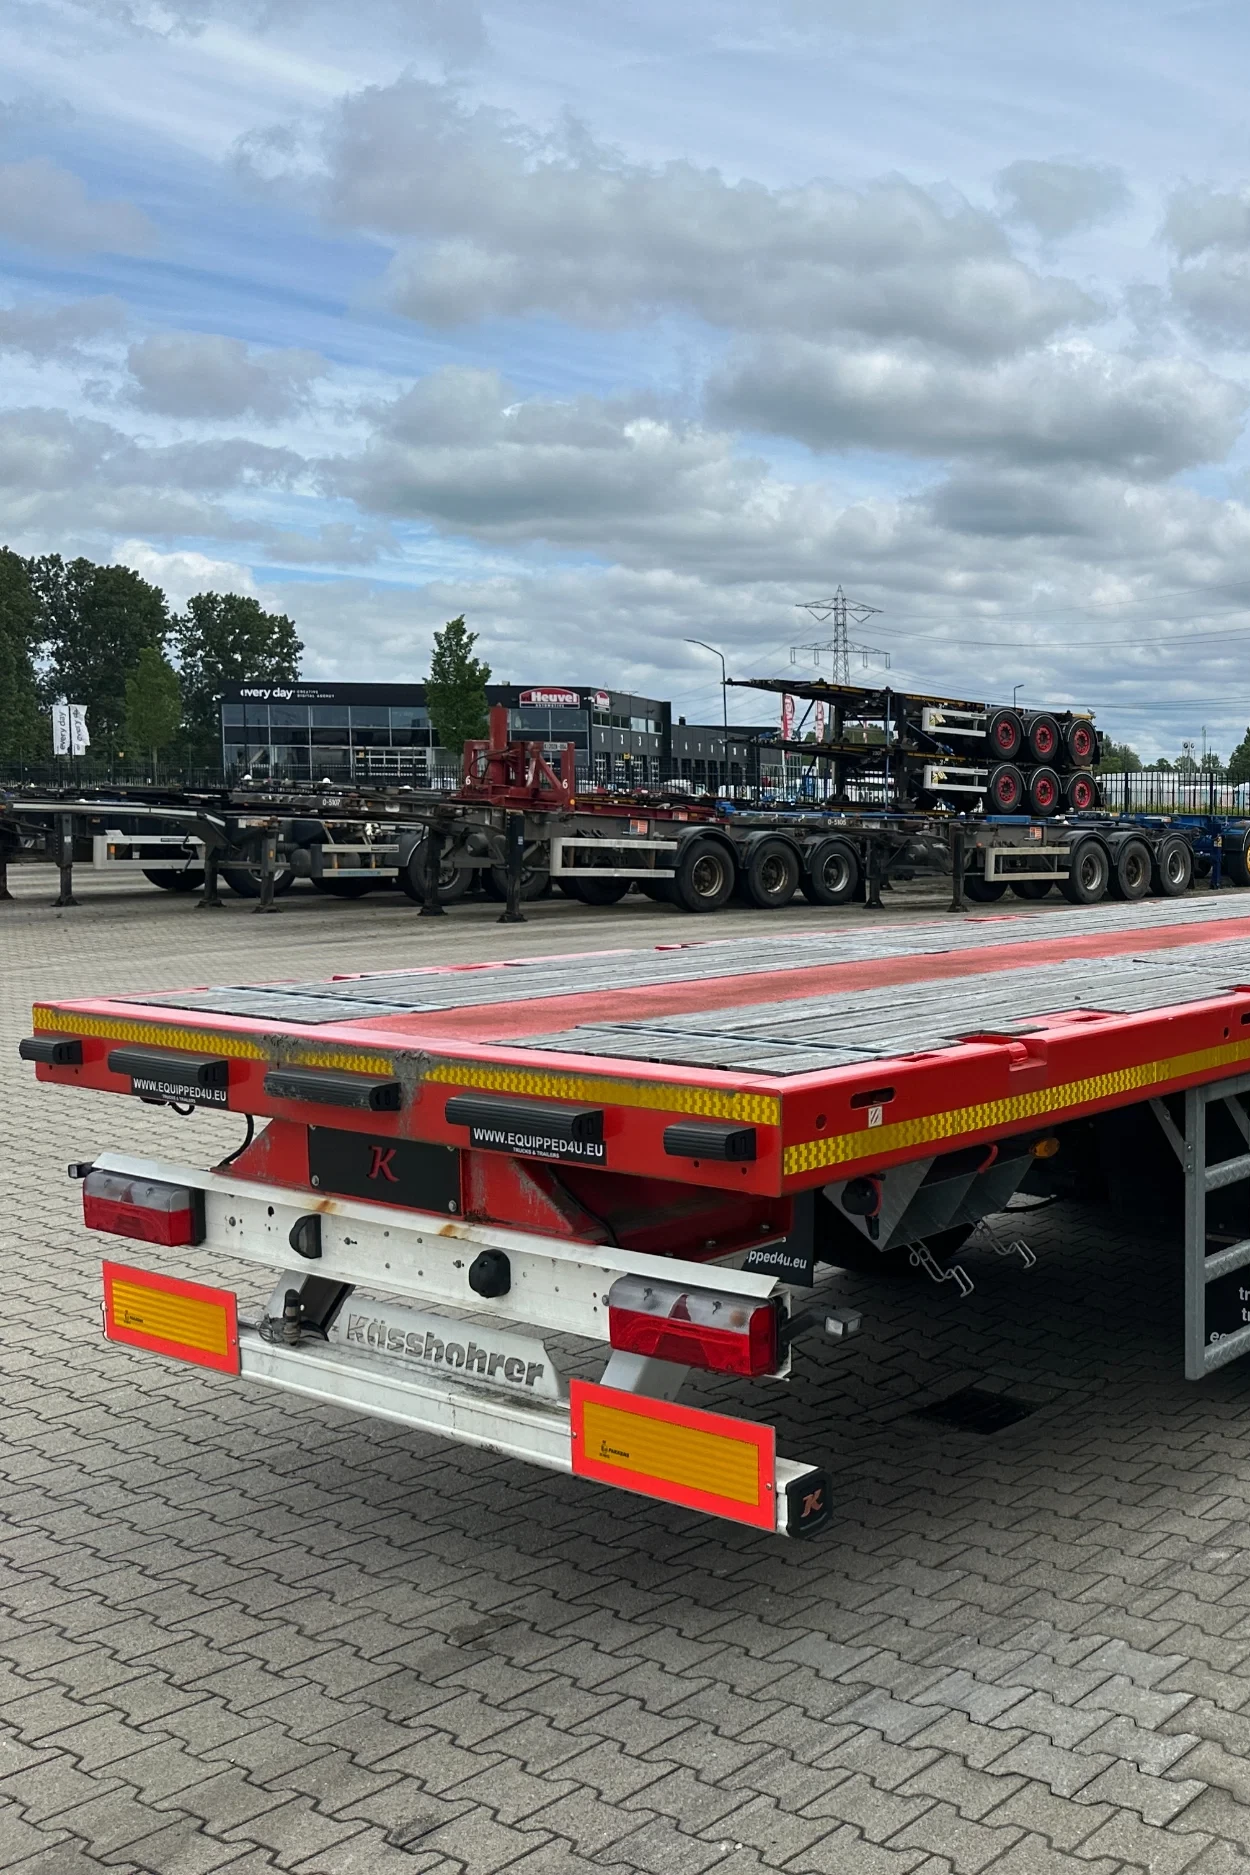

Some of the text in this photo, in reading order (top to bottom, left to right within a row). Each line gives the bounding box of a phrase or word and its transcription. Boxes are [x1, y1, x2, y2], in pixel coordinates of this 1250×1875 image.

[272, 687, 293, 700] day
[530, 691, 578, 703] Heuvel
[465, 775, 471, 785] 6
[562, 779, 568, 789] 6
[133, 1077, 227, 1102] WWW.EQUIPPED4U.EU
[473, 1127, 604, 1157] WWW.EQUIPPED4U.EU
[512, 1146, 532, 1155] TRUCKS
[536, 1150, 560, 1159] TRAILERS
[747, 1250, 807, 1269] pped4u.eu
[346, 1313, 545, 1386] Kässbohrer
